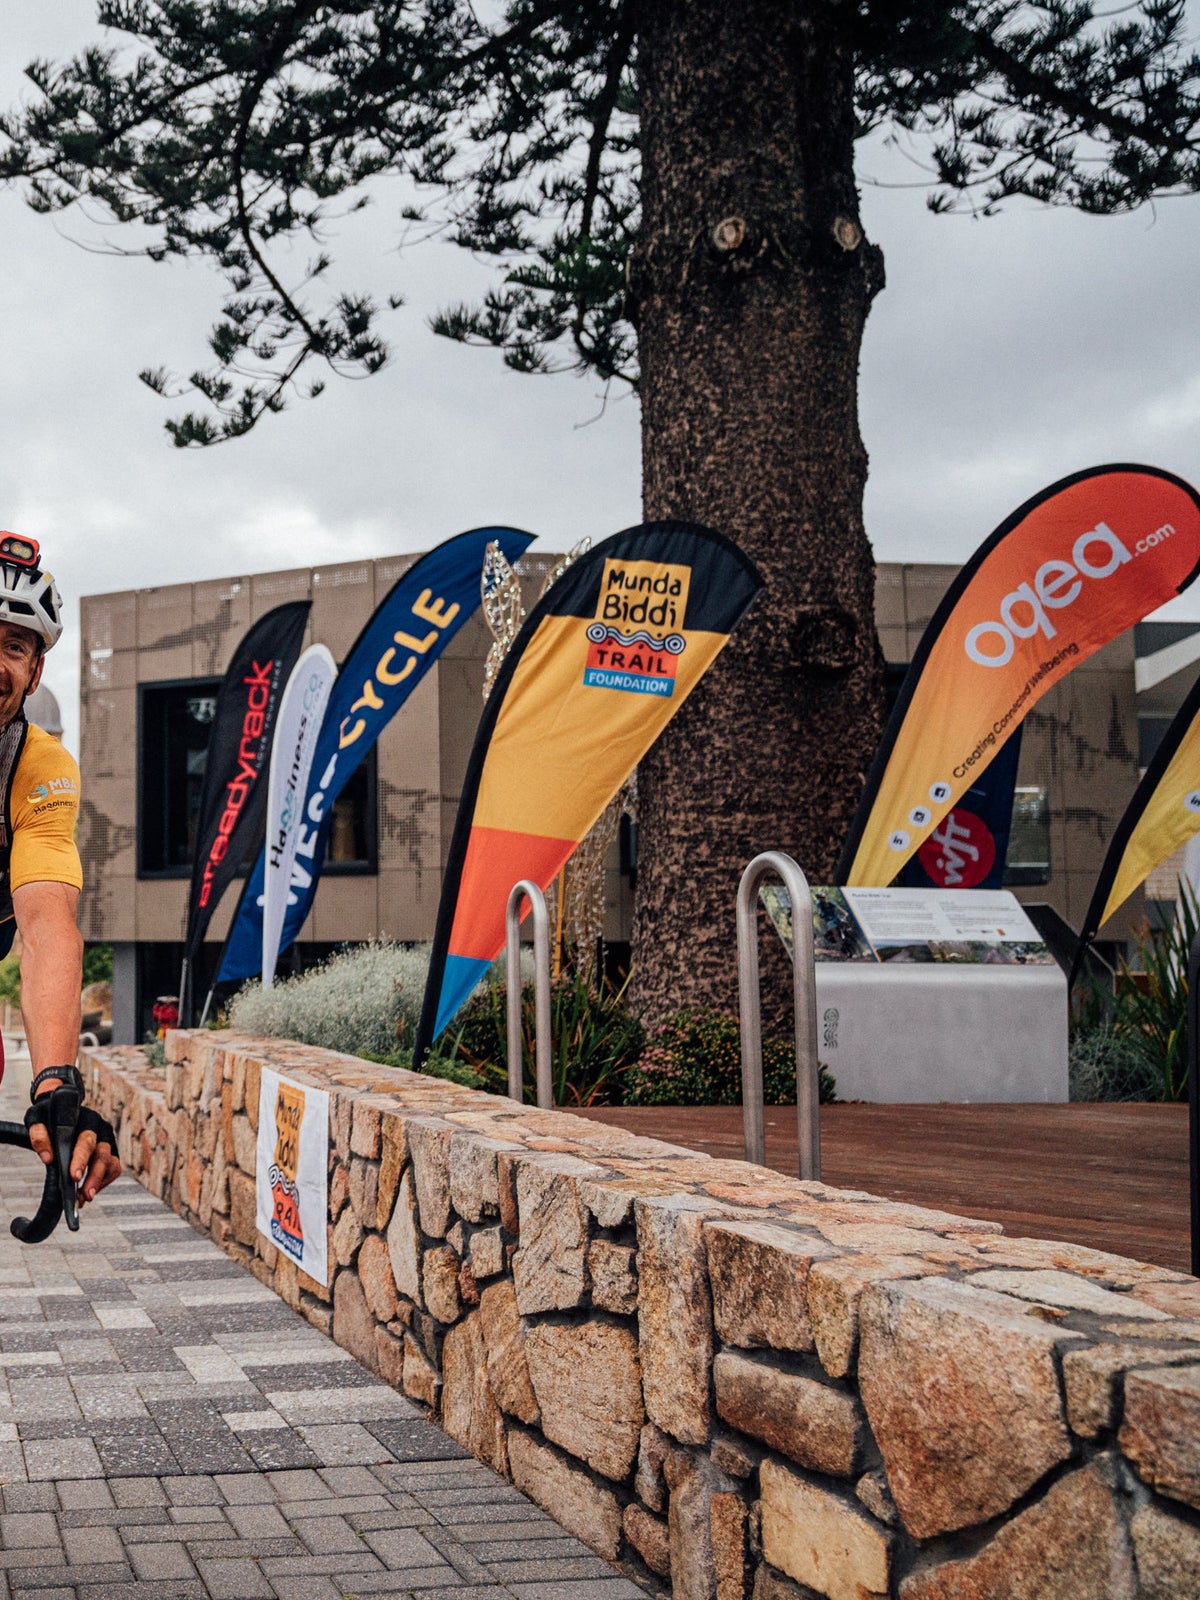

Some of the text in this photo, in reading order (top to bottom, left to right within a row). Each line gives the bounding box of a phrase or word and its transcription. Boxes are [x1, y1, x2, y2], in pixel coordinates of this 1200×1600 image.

[607, 569, 682, 597] Munda
[602, 593, 677, 628] Biddi
[339, 588, 460, 749] CYCLE
[597, 649, 668, 674] TRAIL
[588, 672, 669, 693] FOUNDATION
[952, 731, 997, 779] Creating
[1031, 642, 1080, 688] Wellbeing
[198, 659, 274, 908] steadyrack
